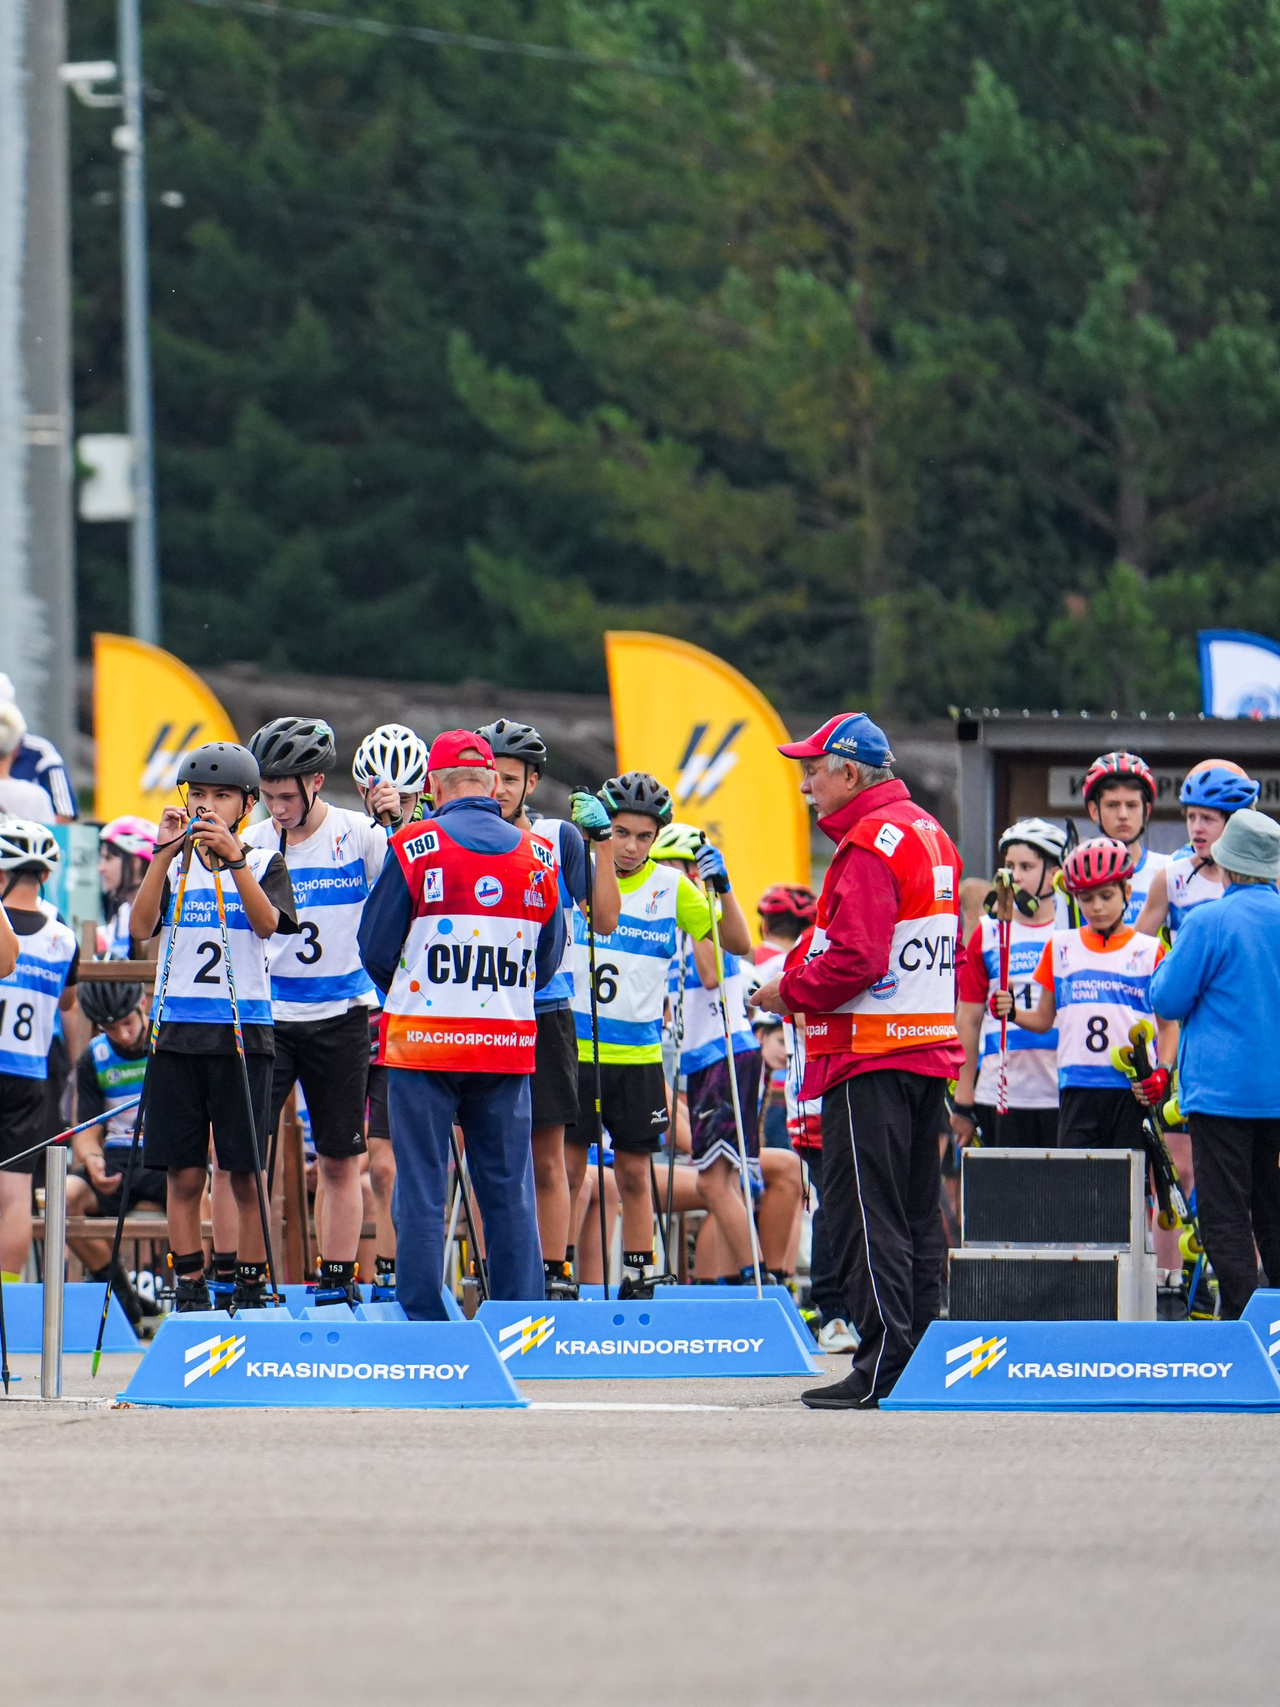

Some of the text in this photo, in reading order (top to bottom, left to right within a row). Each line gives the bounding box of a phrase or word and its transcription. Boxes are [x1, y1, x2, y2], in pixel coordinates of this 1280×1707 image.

[405, 834, 436, 858] 180
[291, 874, 363, 893] АСНОЯРСКИЙ
[183, 910, 212, 923] КРАЙ
[295, 921, 323, 965] 3
[616, 924, 671, 944] НОЯРСКИЙ
[193, 941, 222, 984] 2
[595, 963, 620, 1004] 6
[1071, 979, 1146, 997] КРАСНОЯРСКИЙ
[406, 1030, 517, 1047] КРАСНОЯРСКИЙ
[1085, 1016, 1109, 1052] 8
[628, 1254, 645, 1263] 156
[239, 1265, 257, 1275] 152
[328, 1264, 343, 1273] 153
[556, 1338, 765, 1355] KRASINDORSTROY
[246, 1362, 470, 1381] KRASINDORSTROY
[1008, 1361, 1234, 1379] KRASINDORSTROY
